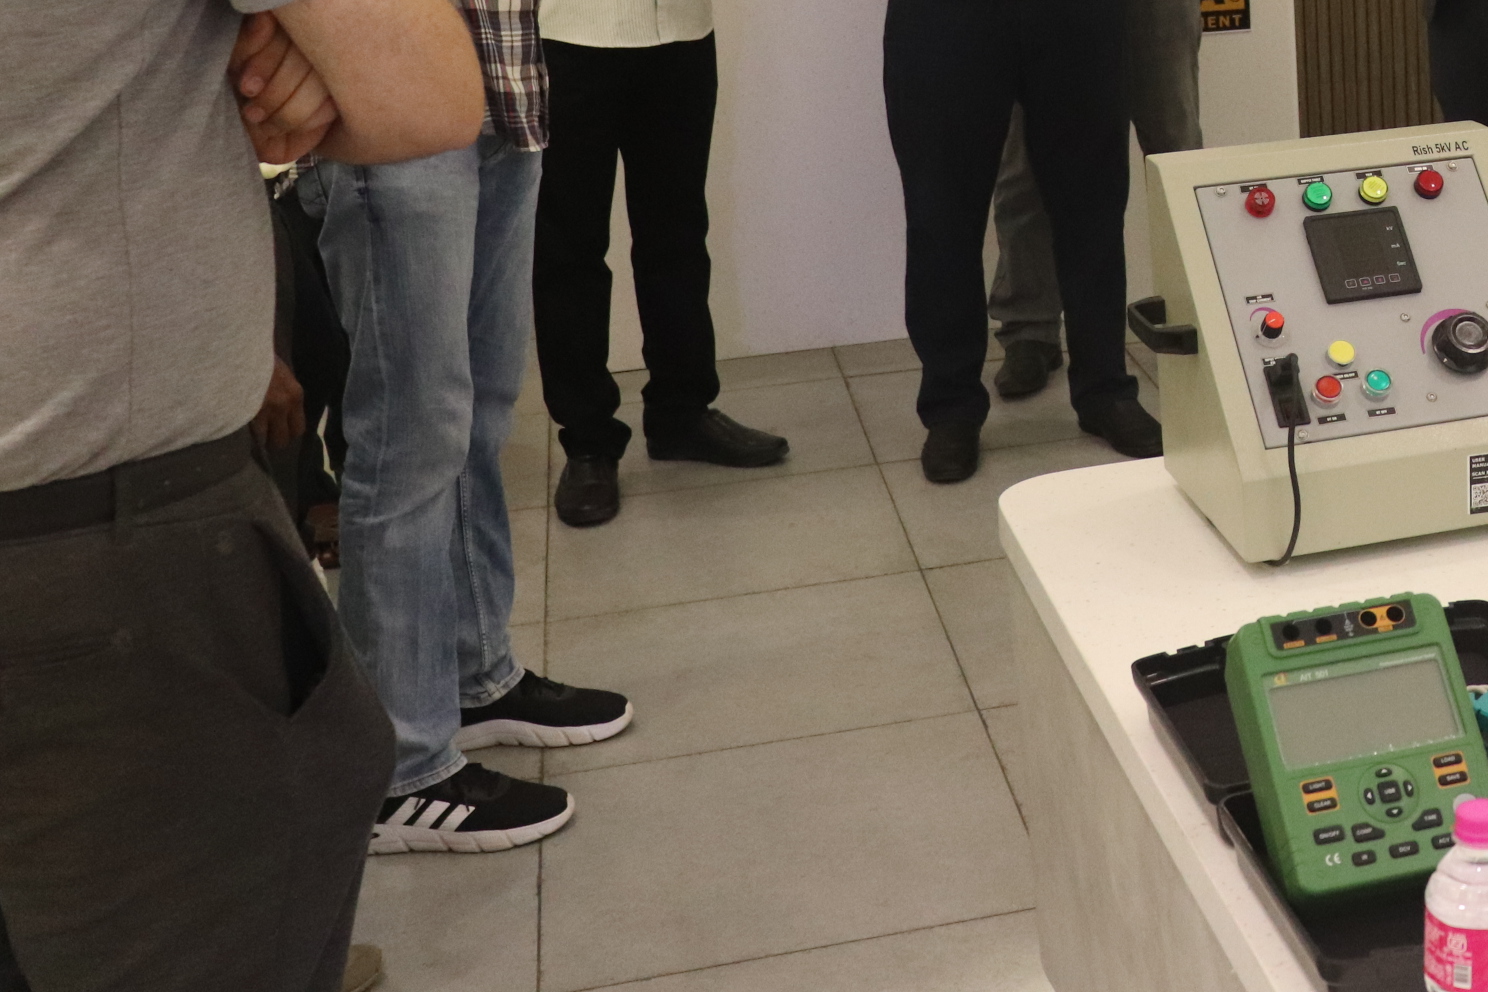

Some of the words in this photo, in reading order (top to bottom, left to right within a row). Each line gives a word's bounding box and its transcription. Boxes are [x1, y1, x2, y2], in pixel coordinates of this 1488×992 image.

[1412, 144, 1434, 156] Rish
[1435, 142, 1451, 153] 5kV
[1455, 140, 1469, 151] AC
[1309, 782, 1326, 790] LIGHT
[1313, 799, 1331, 808] CLEAR
